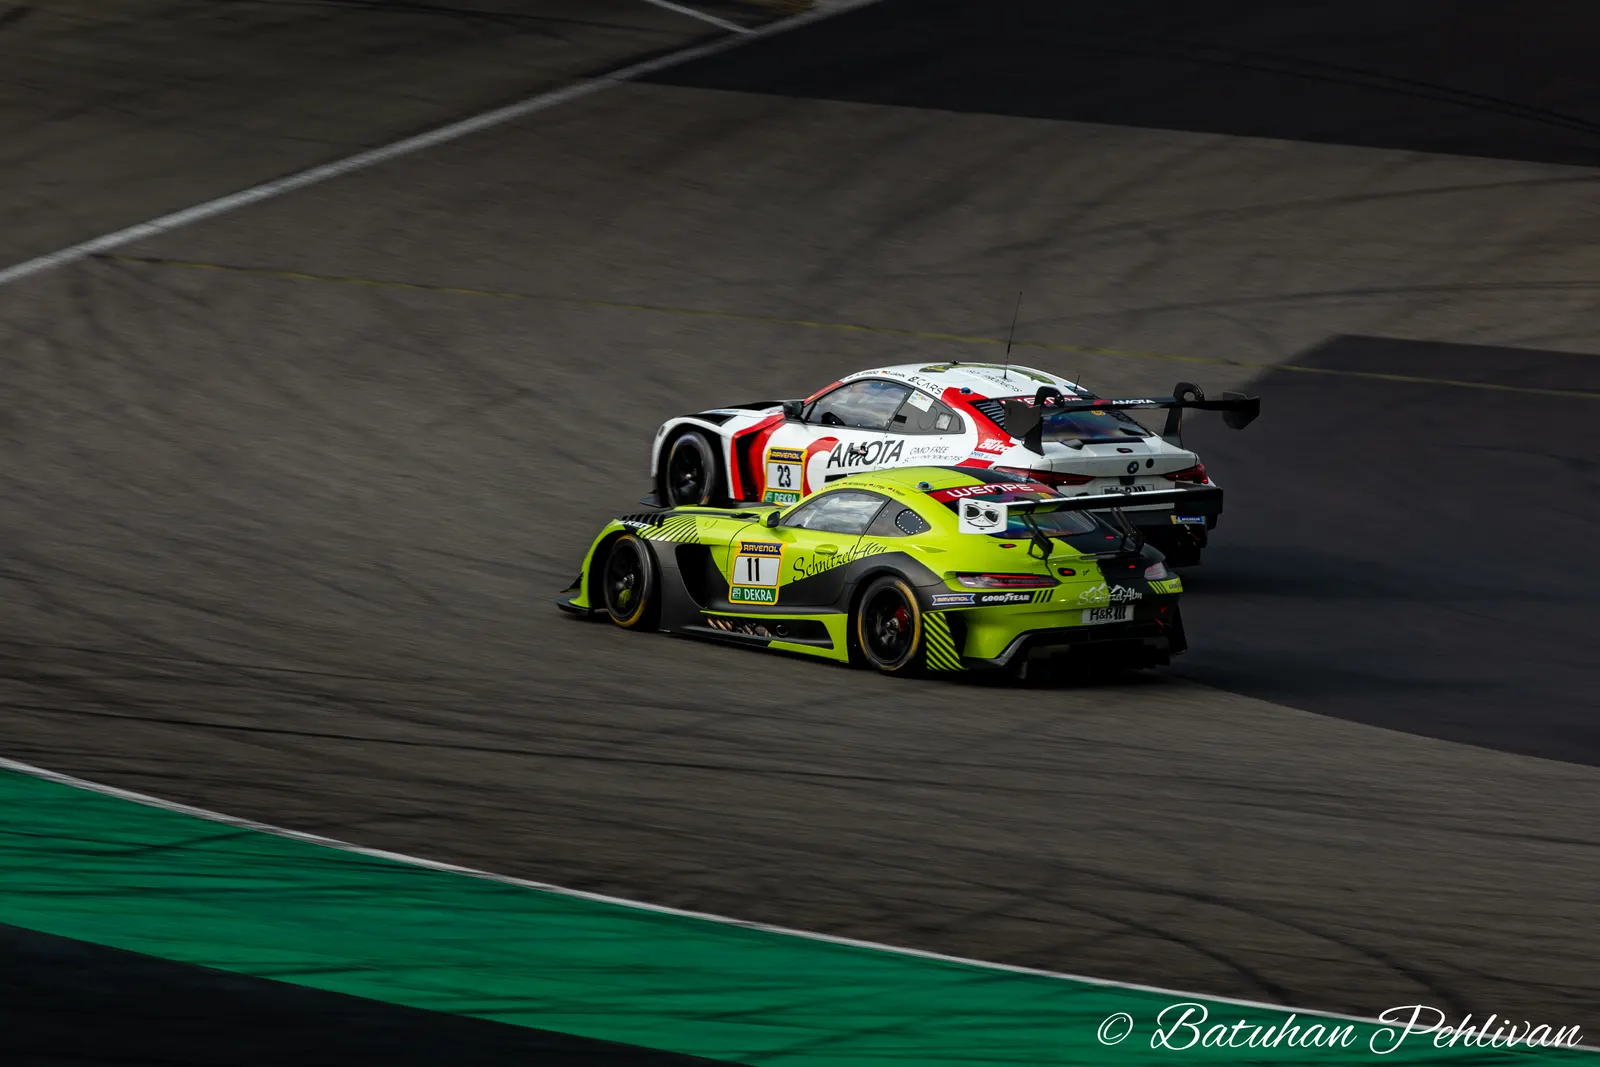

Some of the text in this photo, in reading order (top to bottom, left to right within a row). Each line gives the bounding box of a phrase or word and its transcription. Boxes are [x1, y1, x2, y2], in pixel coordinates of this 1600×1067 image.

[826, 439, 905, 469] AMOTA
[909, 446, 949, 455] GMO FREE
[777, 465, 791, 487] 23
[946, 483, 1035, 498] WEMPE
[774, 492, 797, 503] DEKRA
[743, 544, 779, 552] RAVENOL
[747, 557, 760, 582] 11
[743, 588, 773, 601] DEKRA
[981, 593, 1031, 603] GOODYEAR
